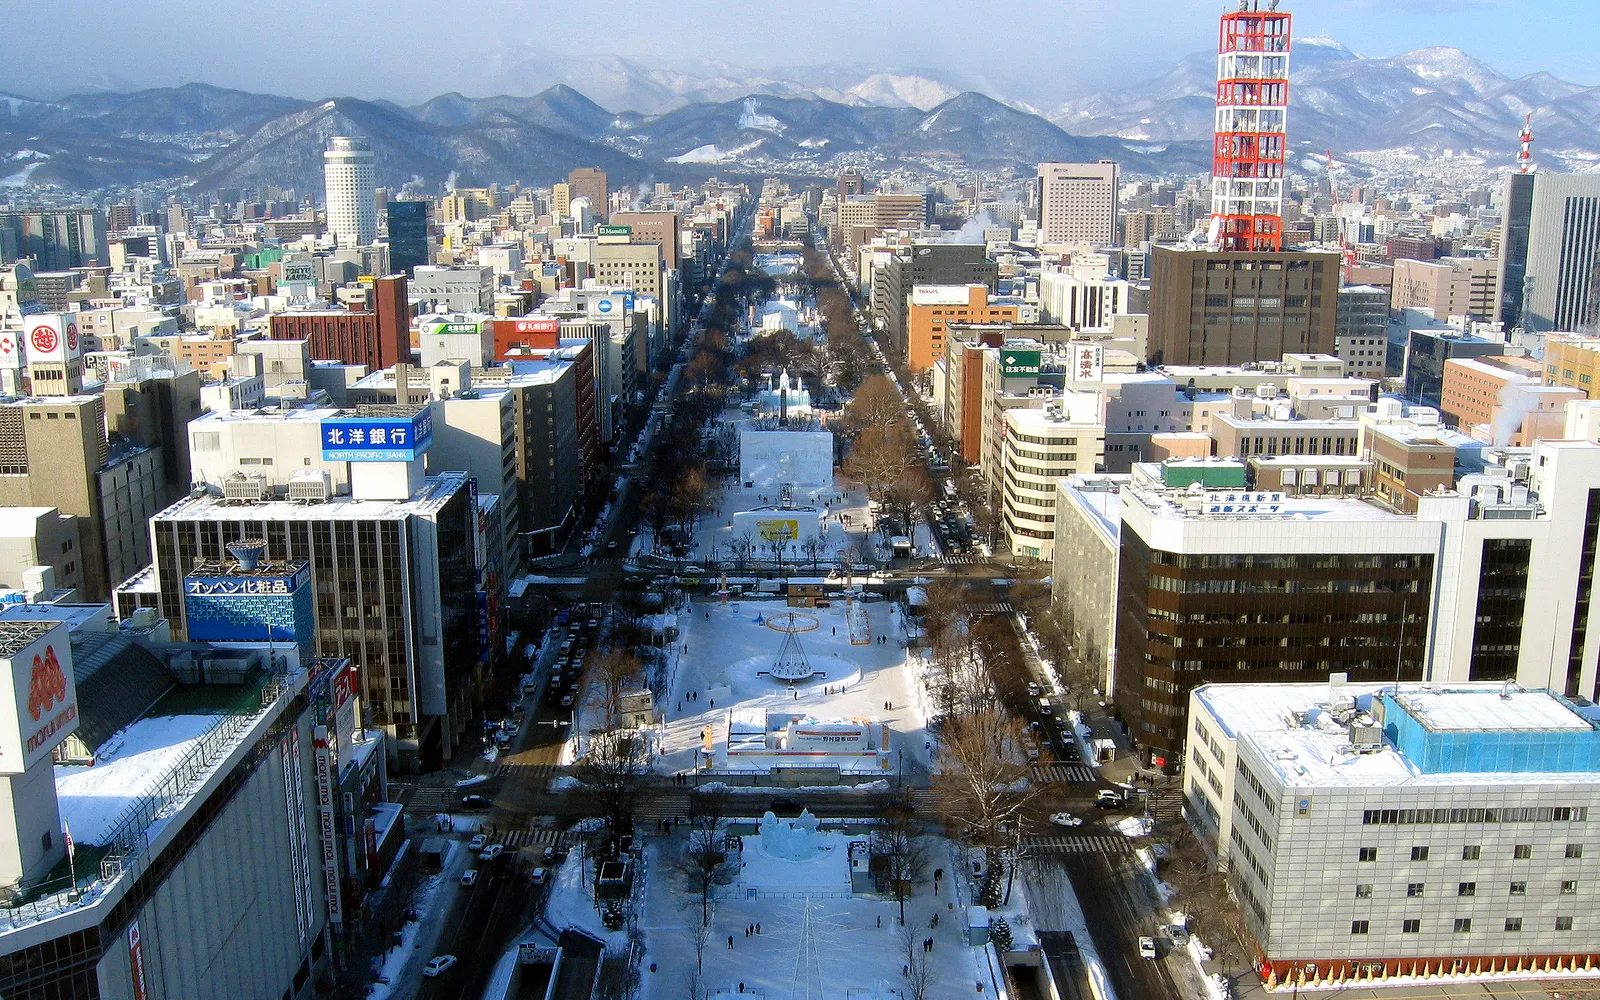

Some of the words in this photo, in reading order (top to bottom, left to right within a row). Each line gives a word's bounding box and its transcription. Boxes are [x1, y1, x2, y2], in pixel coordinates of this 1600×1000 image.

[527, 322, 554, 330] 札幌銀行
[327, 428, 407, 445] 北洋銀行
[328, 451, 354, 459] NORTH
[356, 451, 384, 459] PACIFIC
[386, 451, 407, 459] BANK
[1209, 493, 1281, 502] 北海道新聞
[1209, 504, 1280, 513] 道新スポーツ
[188, 580, 288, 594] オッペン化粧品
